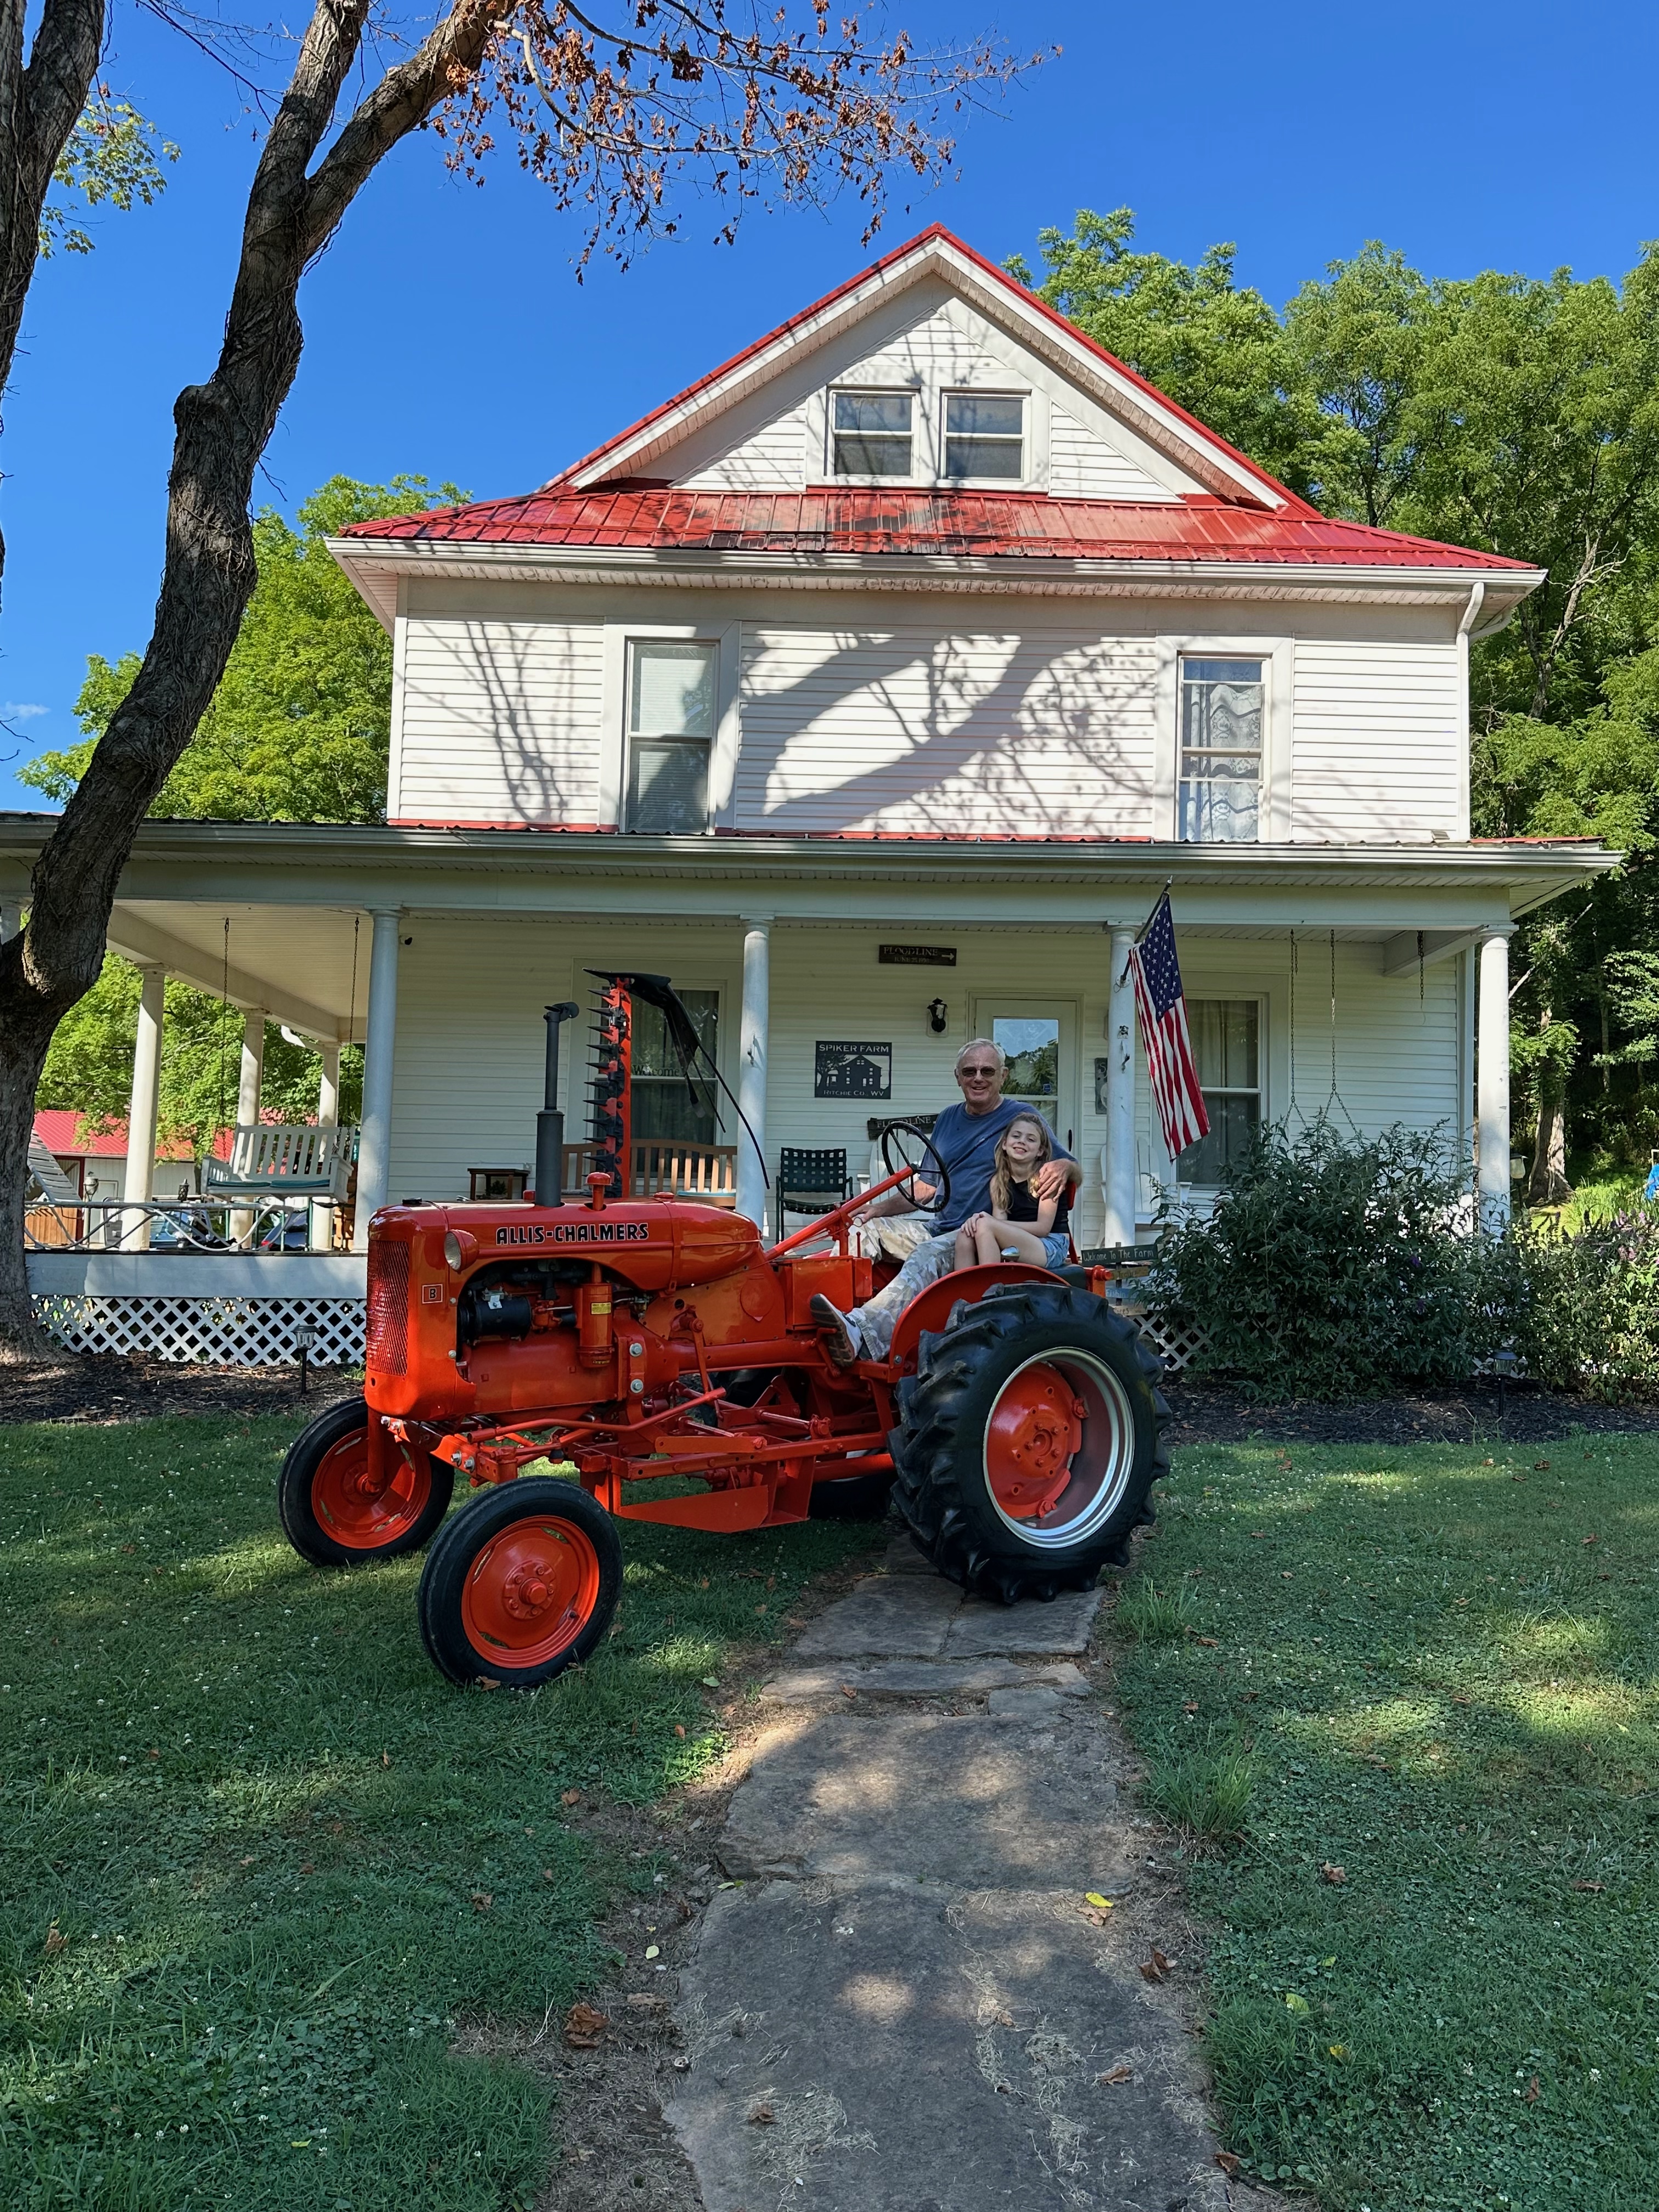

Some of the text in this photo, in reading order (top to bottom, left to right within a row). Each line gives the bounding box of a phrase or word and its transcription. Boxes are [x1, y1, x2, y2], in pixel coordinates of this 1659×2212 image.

[496, 1222, 649, 1246] ALLIS-CHALMERS
[1082, 1248, 1154, 1262] Welcome To The Farm
[429, 1288, 437, 1300] B
